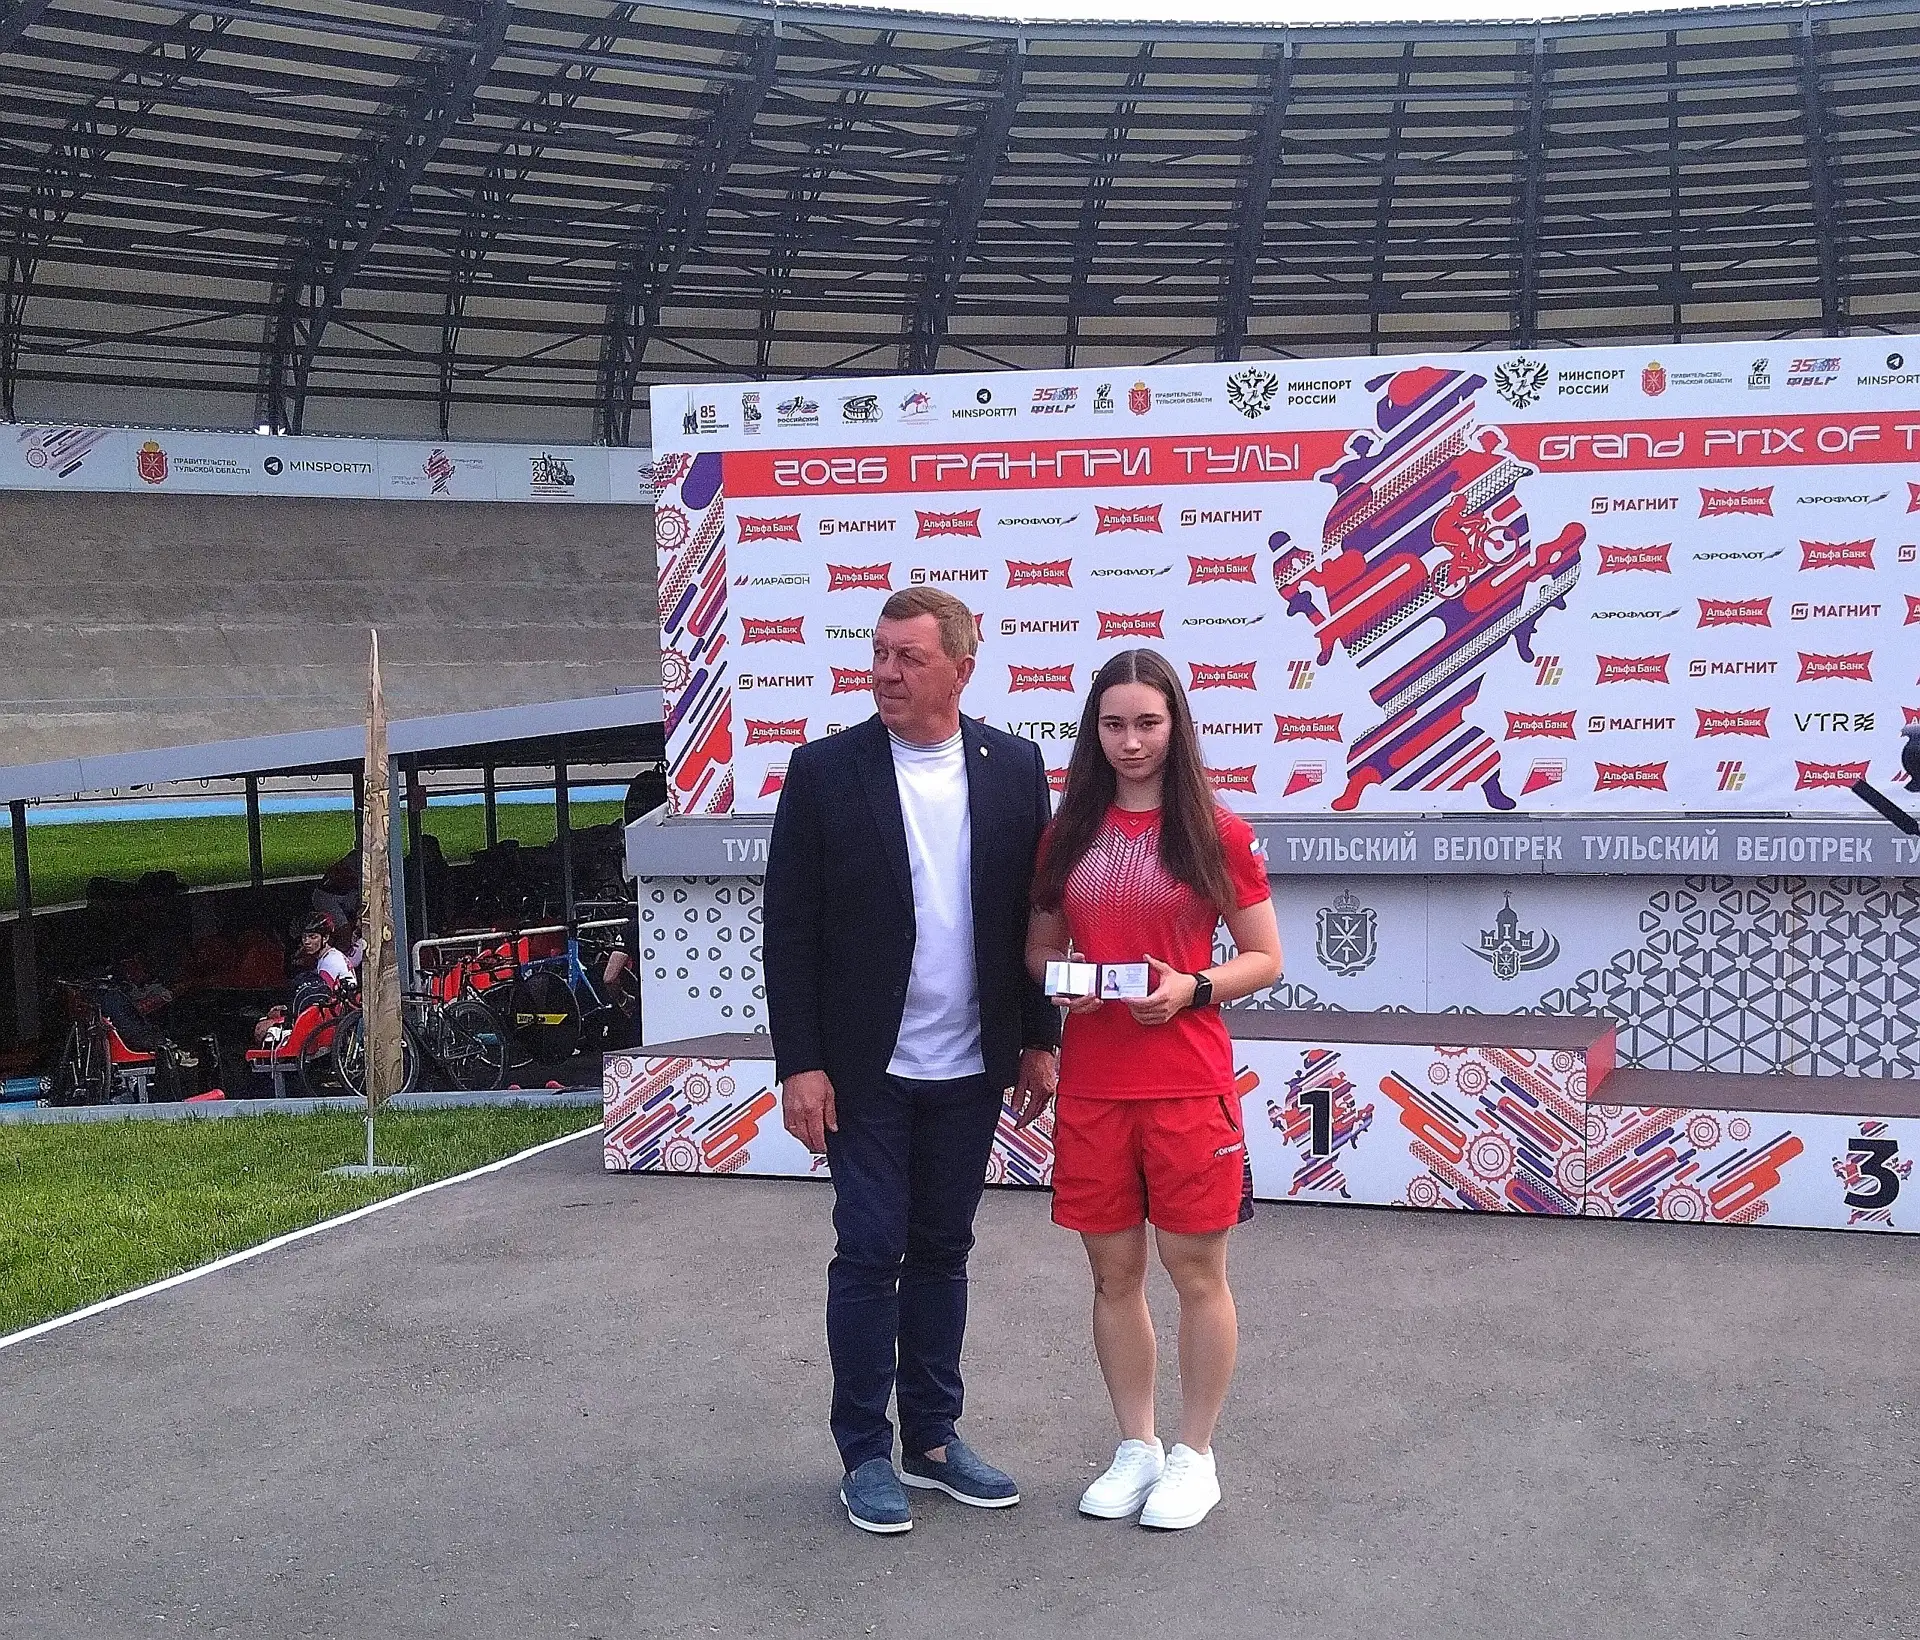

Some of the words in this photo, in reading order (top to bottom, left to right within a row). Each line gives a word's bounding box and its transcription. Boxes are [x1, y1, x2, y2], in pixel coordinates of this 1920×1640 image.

[1558, 369, 1625, 381] МИНСПОРТ
[1288, 380, 1352, 391] МИНСПОРТ
[1558, 384, 1609, 395] РОССИИ
[1288, 394, 1336, 405] РОССИИ
[700, 405, 716, 418] 85
[952, 407, 1017, 418] MINSPORT71
[289, 461, 372, 474] MINSPORT71
[774, 457, 887, 486] 2026
[910, 446, 1151, 481] ГРАН-ПРИ
[1173, 443, 1299, 474] ТУЛЫ
[1612, 498, 1679, 511] МАГНИТ
[1707, 496, 1739, 509] Альфа
[1741, 496, 1766, 506] Банк
[1796, 495, 1870, 505] АЭРОФЛОТ
[997, 516, 1062, 526] АЭРОФЛОТ
[1103, 514, 1131, 525] Альфа
[1133, 513, 1155, 523] Банк
[1200, 510, 1262, 523] МАГНИТ
[745, 524, 771, 534] Альфа
[773, 523, 794, 532] Банк
[838, 520, 896, 533] МАГНИТ
[922, 518, 951, 530] Альфа
[952, 518, 974, 528] Банк
[1606, 554, 1637, 565] Альфа
[1639, 553, 1663, 563] Банк
[1692, 551, 1764, 561] АЭРОФЛОТ
[1807, 549, 1840, 561] Альфа
[1843, 549, 1867, 559] Банк
[1014, 568, 1041, 579] Альфа
[1044, 567, 1065, 577] Банк
[1090, 568, 1155, 577] АЭРОФЛОТ
[1195, 564, 1224, 576] Альфа
[1227, 563, 1248, 573] Банк
[751, 576, 810, 585] МАРАФОН
[834, 572, 862, 583] Альфа
[864, 571, 885, 581] Банк
[929, 570, 989, 582] МАГНИТ
[1590, 610, 1662, 620] АЭРОФЛОТ
[1705, 607, 1737, 619] Альфа
[1740, 607, 1764, 616] Банк
[1813, 604, 1881, 618] МАГНИТ
[1020, 620, 1080, 633] МАГНИТ
[1105, 619, 1133, 630] Альфа
[1135, 619, 1157, 629] Банк
[1182, 617, 1248, 626] АЭРОФЛОТ
[748, 625, 776, 636] Альфа
[777, 625, 798, 634] Банк
[1604, 664, 1636, 676] Альфа
[1638, 663, 1661, 673] Банк
[1711, 661, 1778, 675] МАГНИТ
[1805, 661, 1838, 673] Альфа
[1840, 661, 1865, 671] Банк
[757, 675, 814, 688] МАГНИТ
[838, 675, 866, 686] Альфа
[1016, 673, 1044, 684] Альфа
[1046, 673, 1067, 682] Банк
[1196, 671, 1225, 682] Альфа
[1227, 670, 1249, 680] Банк
[1202, 722, 1263, 735] МАГНИТ
[1282, 723, 1311, 734] Альфа
[1313, 722, 1335, 732] Банк
[1512, 720, 1543, 731] Альфа
[1545, 719, 1568, 729] Банк
[1609, 717, 1676, 730] МАГНИТ
[1703, 717, 1735, 730] Альфа
[1738, 717, 1761, 727] Банк
[1794, 713, 1849, 732] VTR
[752, 727, 779, 738] Альфа
[780, 727, 801, 736] Банк
[1227, 774, 1249, 783] Банк
[1603, 771, 1634, 783] Альфа
[1636, 770, 1659, 780] Банк
[1287, 831, 1417, 861] ТУЛЬСКИЙ
[1434, 835, 1563, 862] ВЕЛОТРЕК
[1582, 830, 1719, 862] ТУЛЬСКИЙ
[1737, 836, 1873, 864] ВЕЛОТРЕК
[1301, 1091, 1332, 1156] 1
[1845, 1139, 1901, 1208] 3
